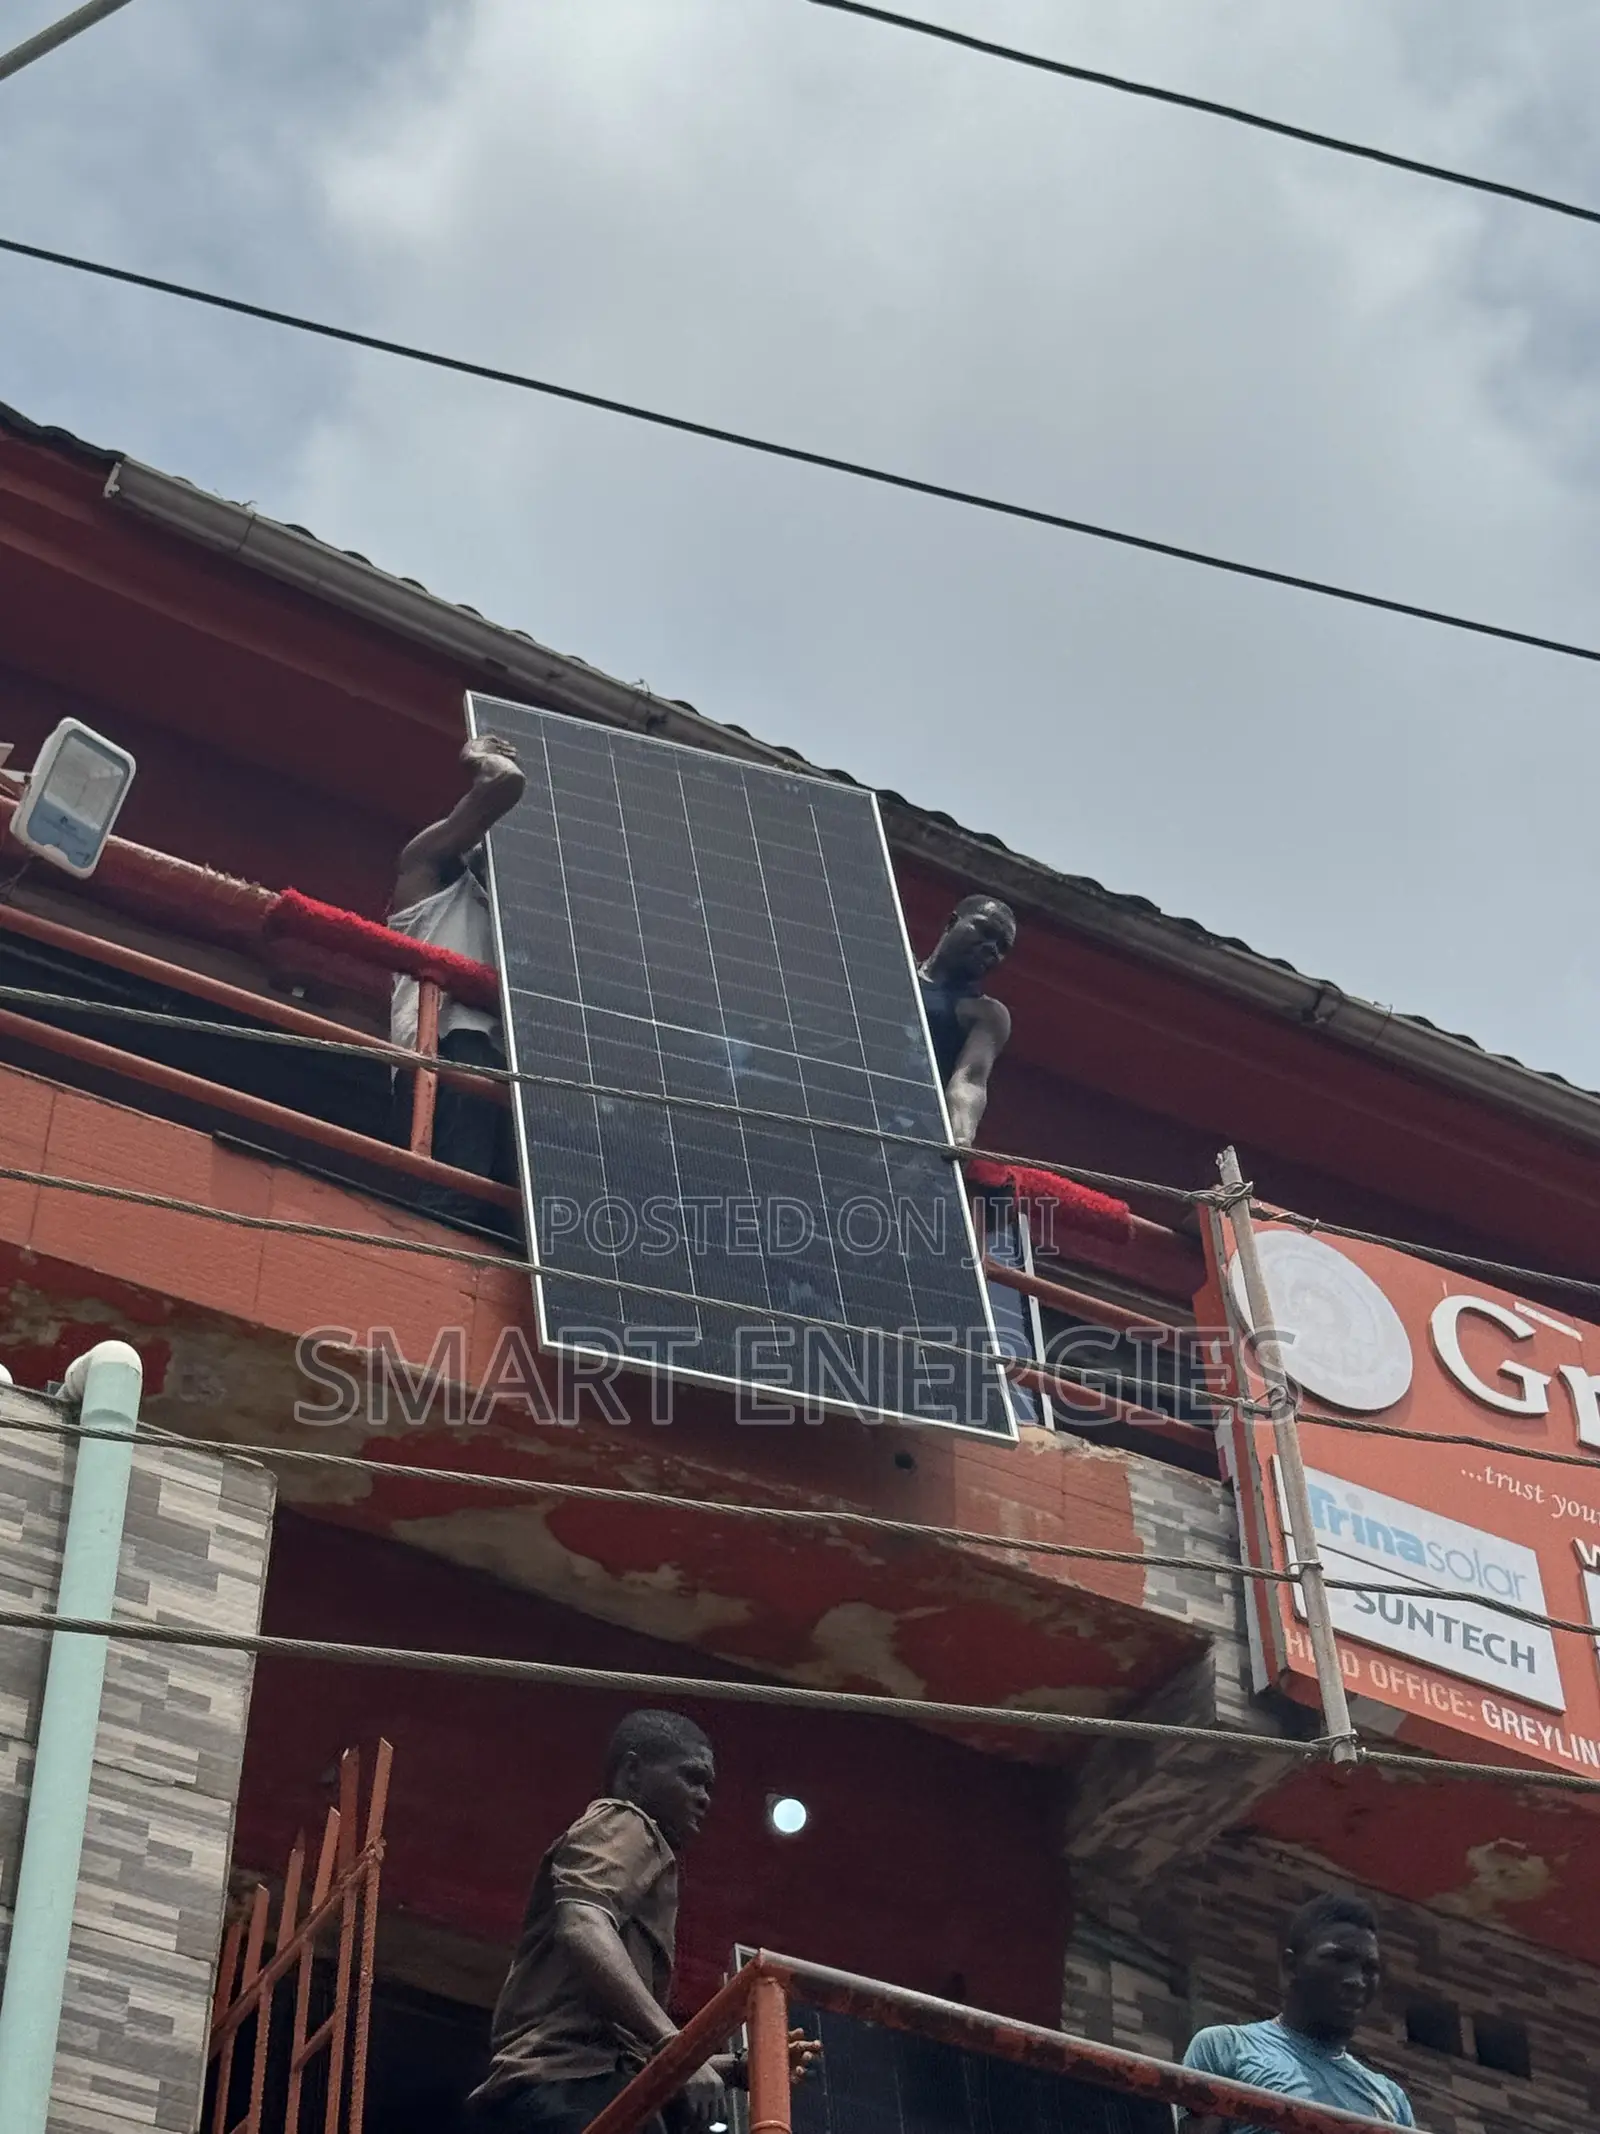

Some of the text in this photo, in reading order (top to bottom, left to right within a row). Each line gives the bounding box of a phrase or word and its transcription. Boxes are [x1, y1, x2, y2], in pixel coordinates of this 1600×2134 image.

[1353, 1590, 1536, 1674] SUNTECH
[1283, 1627, 1600, 1769] HD OFFICE: GREYLIN
